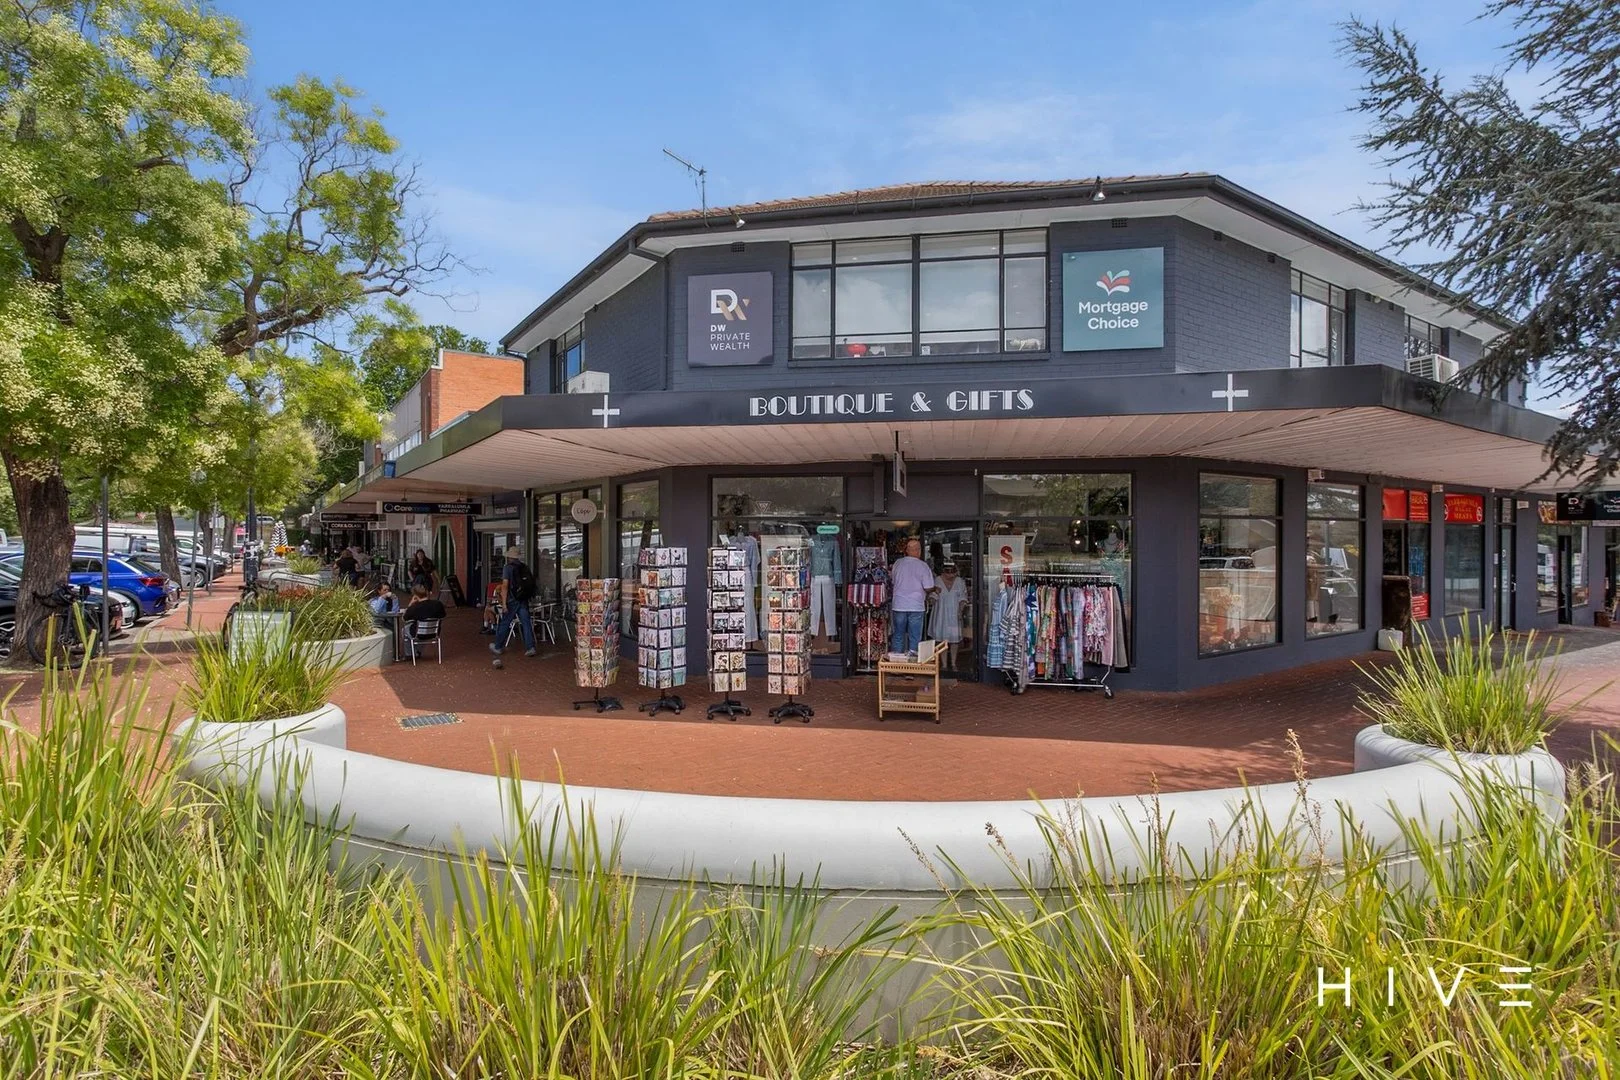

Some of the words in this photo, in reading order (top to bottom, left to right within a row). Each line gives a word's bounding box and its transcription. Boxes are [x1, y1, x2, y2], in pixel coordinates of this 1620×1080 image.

[1078, 299, 1149, 316] Mortgage
[710, 324, 726, 332] DW
[1087, 315, 1140, 330] Choice
[710, 332, 751, 342] PRIVATE
[710, 342, 750, 351] WEALTH
[749, 392, 894, 417] BOUTIQUE
[910, 391, 932, 412] &
[946, 389, 1034, 412] GIFTS
